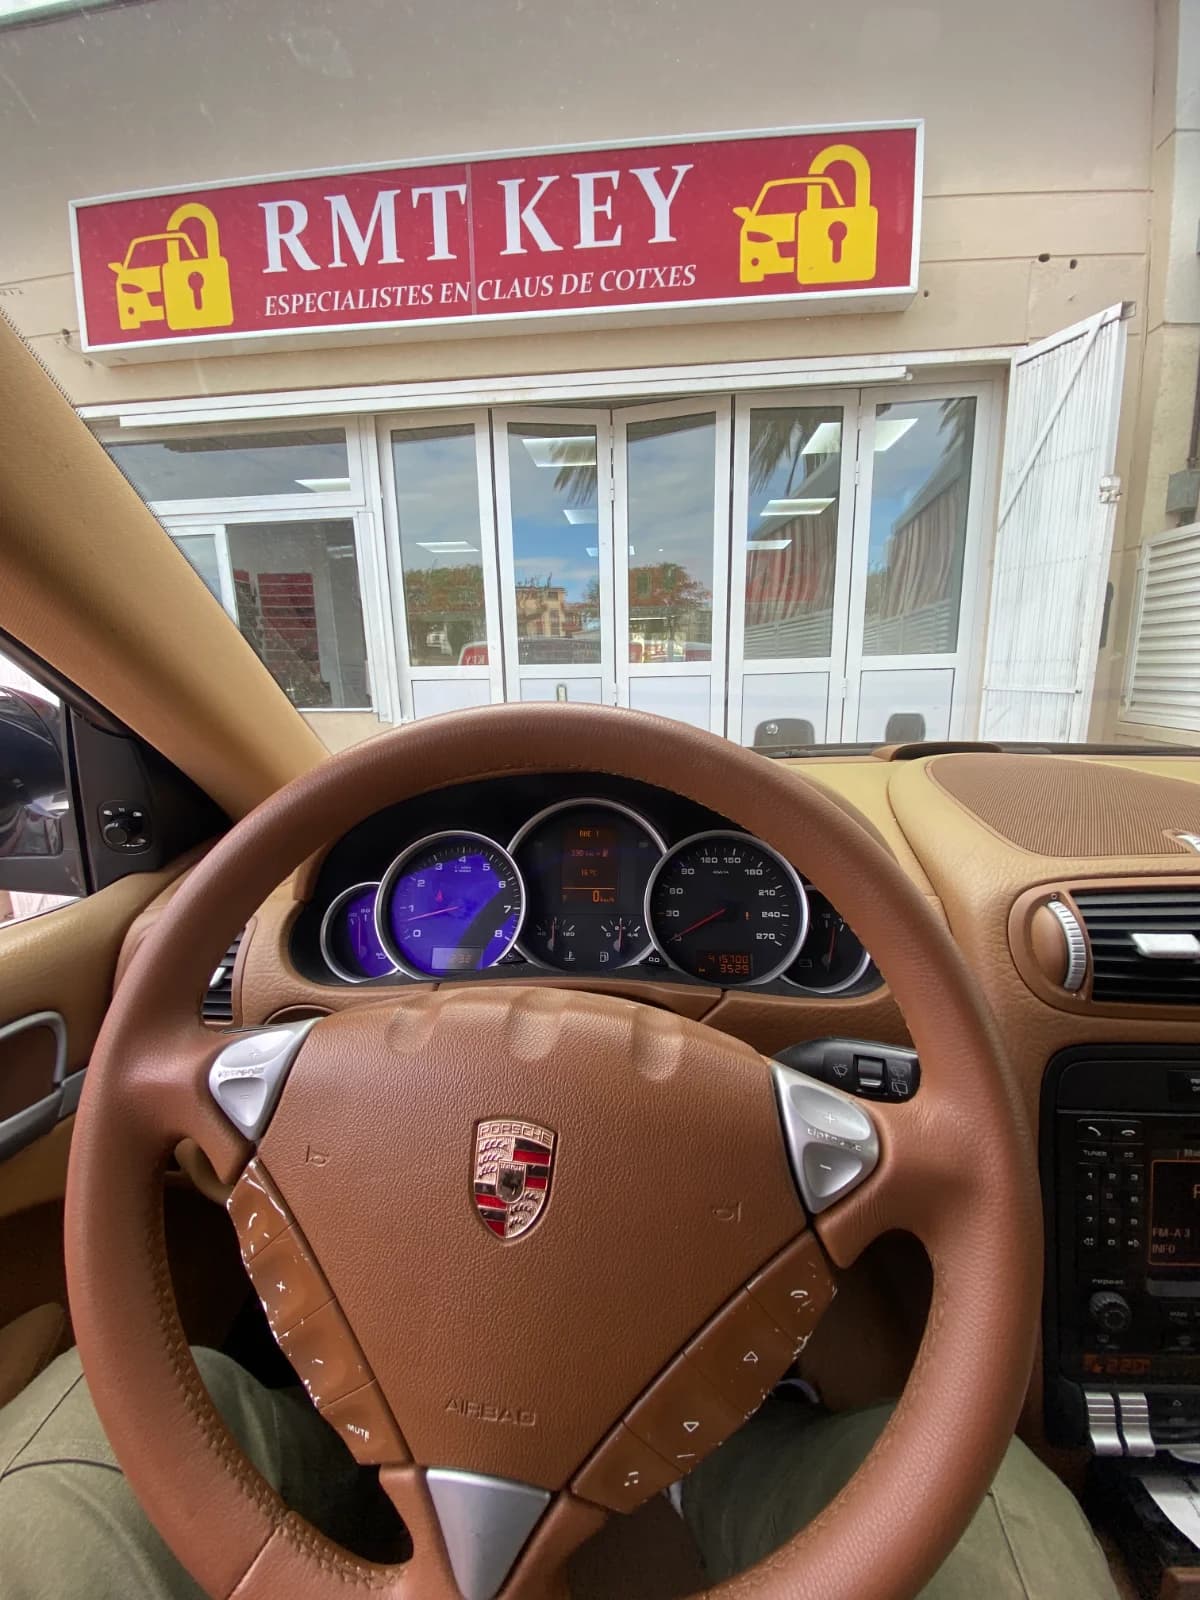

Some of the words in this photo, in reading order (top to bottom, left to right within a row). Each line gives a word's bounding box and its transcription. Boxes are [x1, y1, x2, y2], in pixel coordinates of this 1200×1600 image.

[258, 183, 467, 274] RMT
[497, 164, 694, 256] KEY
[264, 283, 433, 317] ESPECIALISTES
[440, 281, 470, 304] EN
[477, 274, 553, 301] CLAUS
[560, 271, 594, 295] DE
[599, 264, 697, 292] COTXES
[458, 855, 466, 864] 4
[435, 863, 443, 871] 3
[482, 863, 491, 872] 5
[744, 868, 763, 876] 180
[416, 880, 426, 888] 2
[498, 880, 506, 889] 6
[408, 904, 415, 912] 1
[503, 905, 512, 914] 7
[413, 929, 422, 938] 0
[494, 929, 503, 938] 8
[480, 1123, 552, 1149] PORSCHE
[445, 1398, 536, 1427] AIRBAG
[346, 1423, 370, 1442] MUTE
